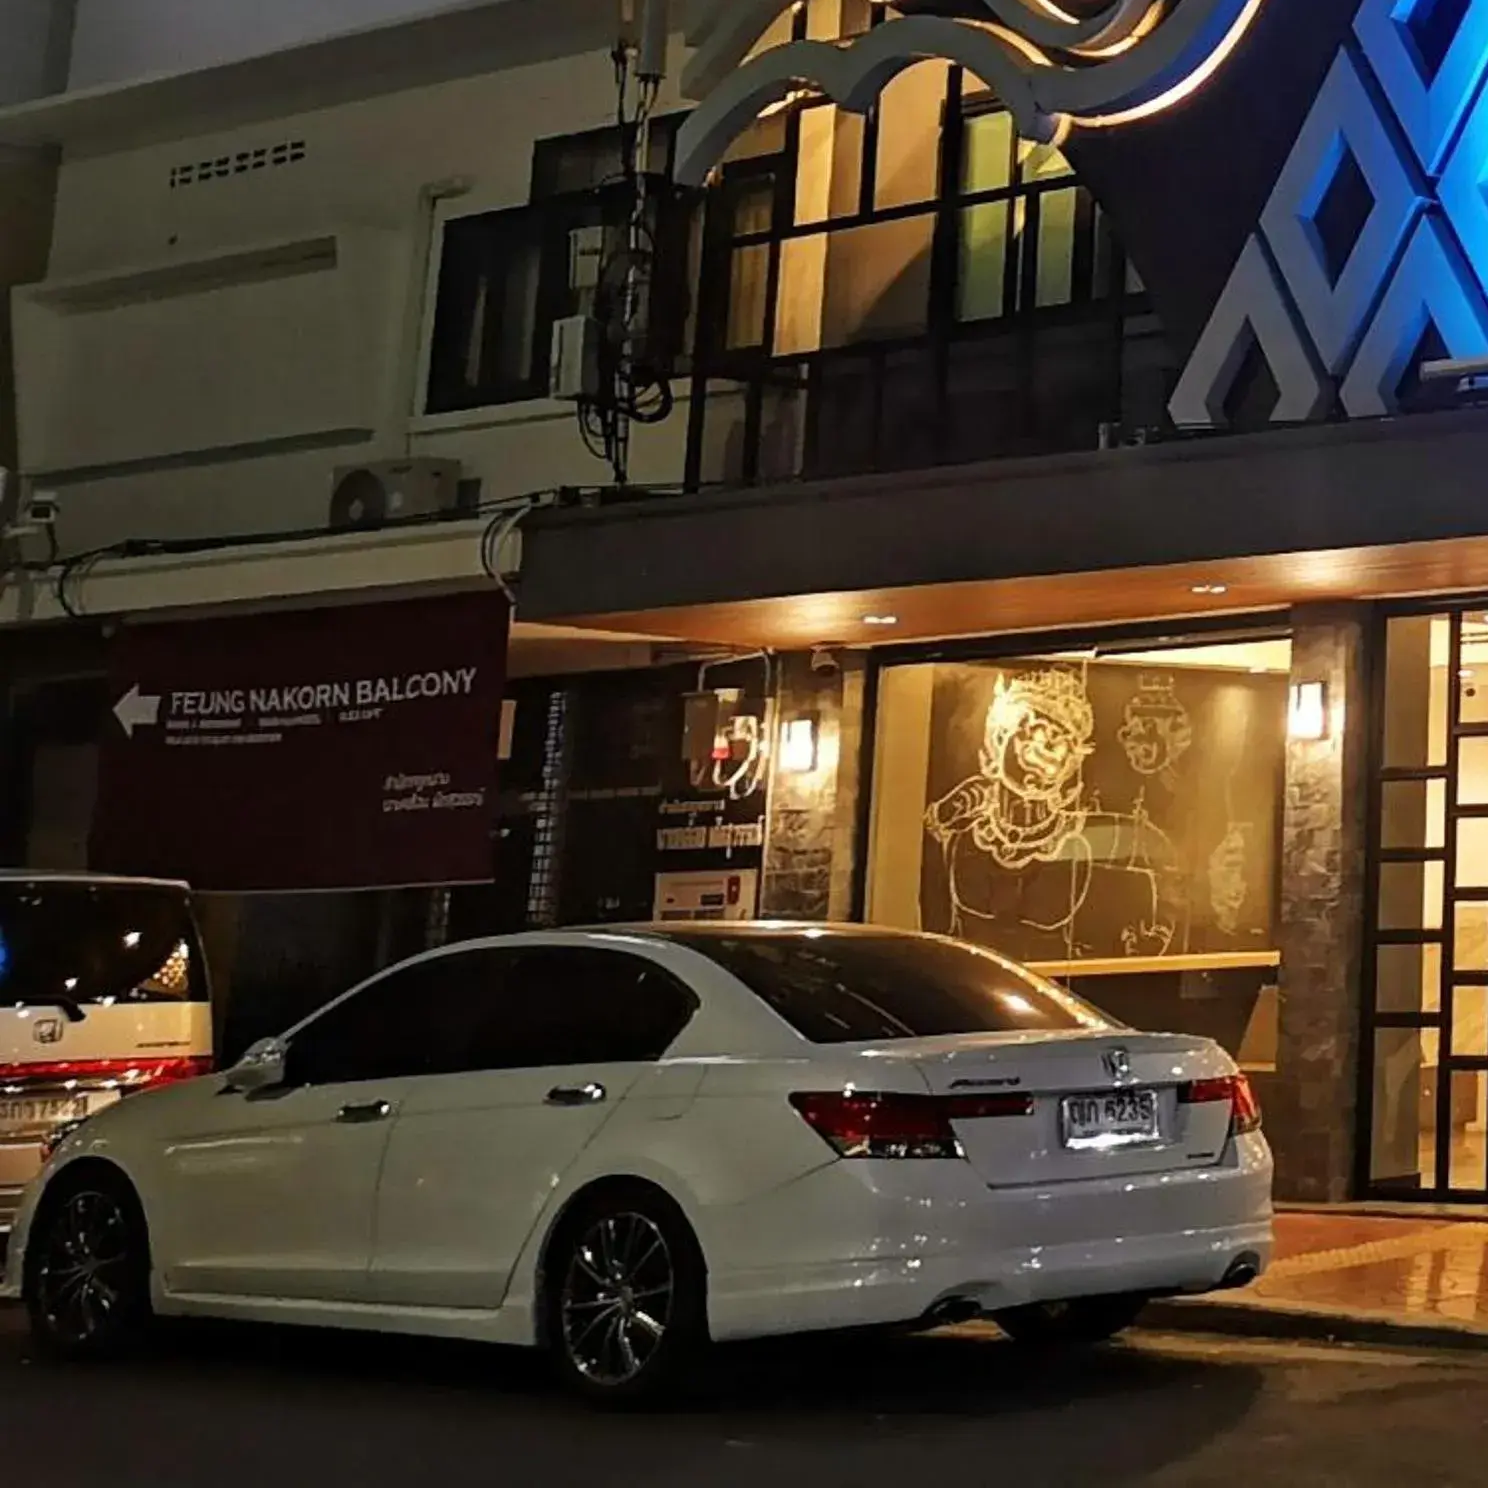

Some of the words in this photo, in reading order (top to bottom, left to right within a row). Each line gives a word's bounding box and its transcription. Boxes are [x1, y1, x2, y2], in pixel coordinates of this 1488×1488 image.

[171, 689, 245, 716] FEUNG
[249, 682, 350, 712] NAKORN
[356, 667, 477, 705] BALCONY
